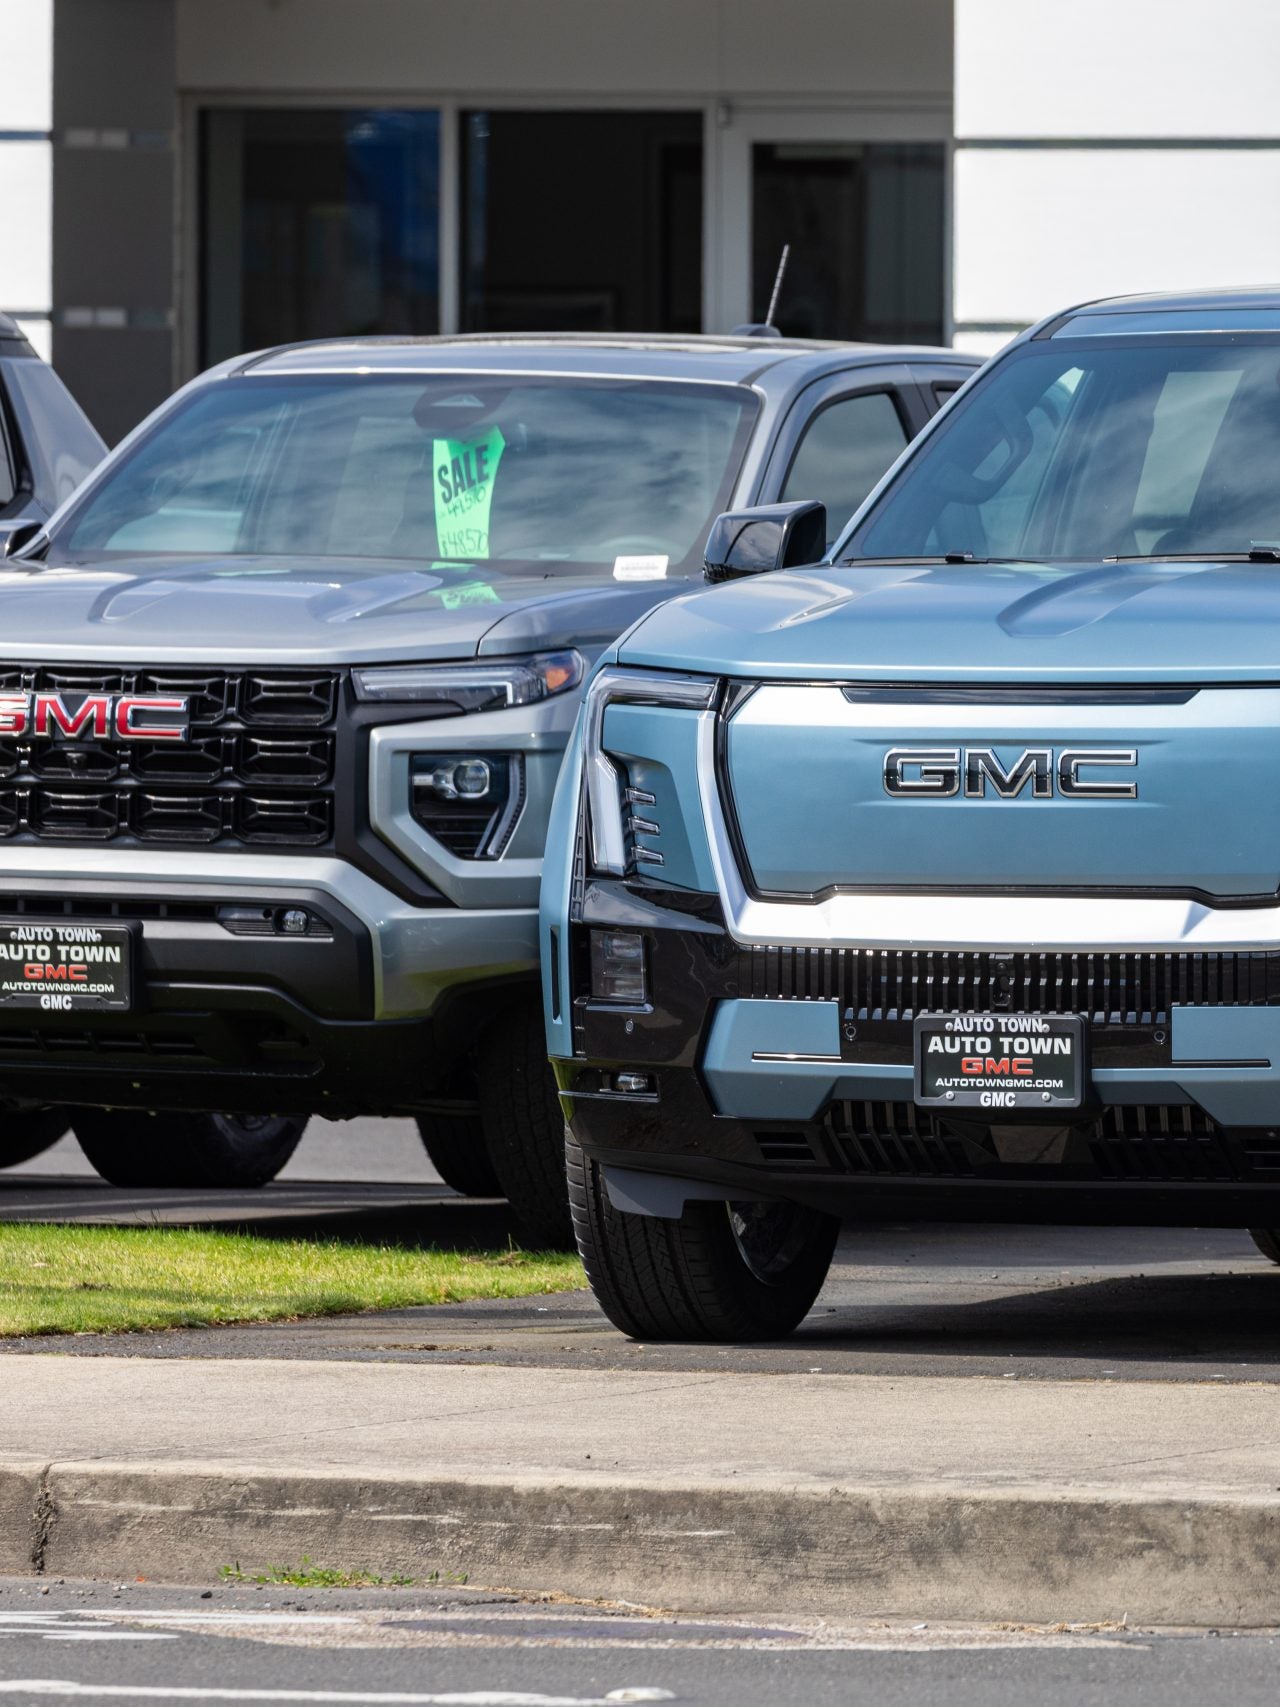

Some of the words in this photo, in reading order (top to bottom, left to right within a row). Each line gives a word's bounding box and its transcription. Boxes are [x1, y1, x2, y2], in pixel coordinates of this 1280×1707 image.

[437, 443, 489, 504] SALE
[883, 748, 1138, 798] GMC
[17, 927, 53, 942] AUTO
[56, 928, 97, 942] TOWN
[0, 944, 51, 961] AUTO
[57, 945, 121, 963] TOWN
[24, 963, 88, 980] GMC
[2, 981, 115, 993] AUTOTOWNGMC.COM
[40, 994, 72, 1010] GMC
[953, 1017, 994, 1032] AUTO
[998, 1018, 1043, 1033] TOWN
[927, 1036, 992, 1054] AUTO
[999, 1037, 1071, 1055] TOWN
[961, 1057, 1034, 1075] GMC
[935, 1078, 1064, 1089] AUTOTOWNGMC.COM
[980, 1092, 1016, 1108] GMC
